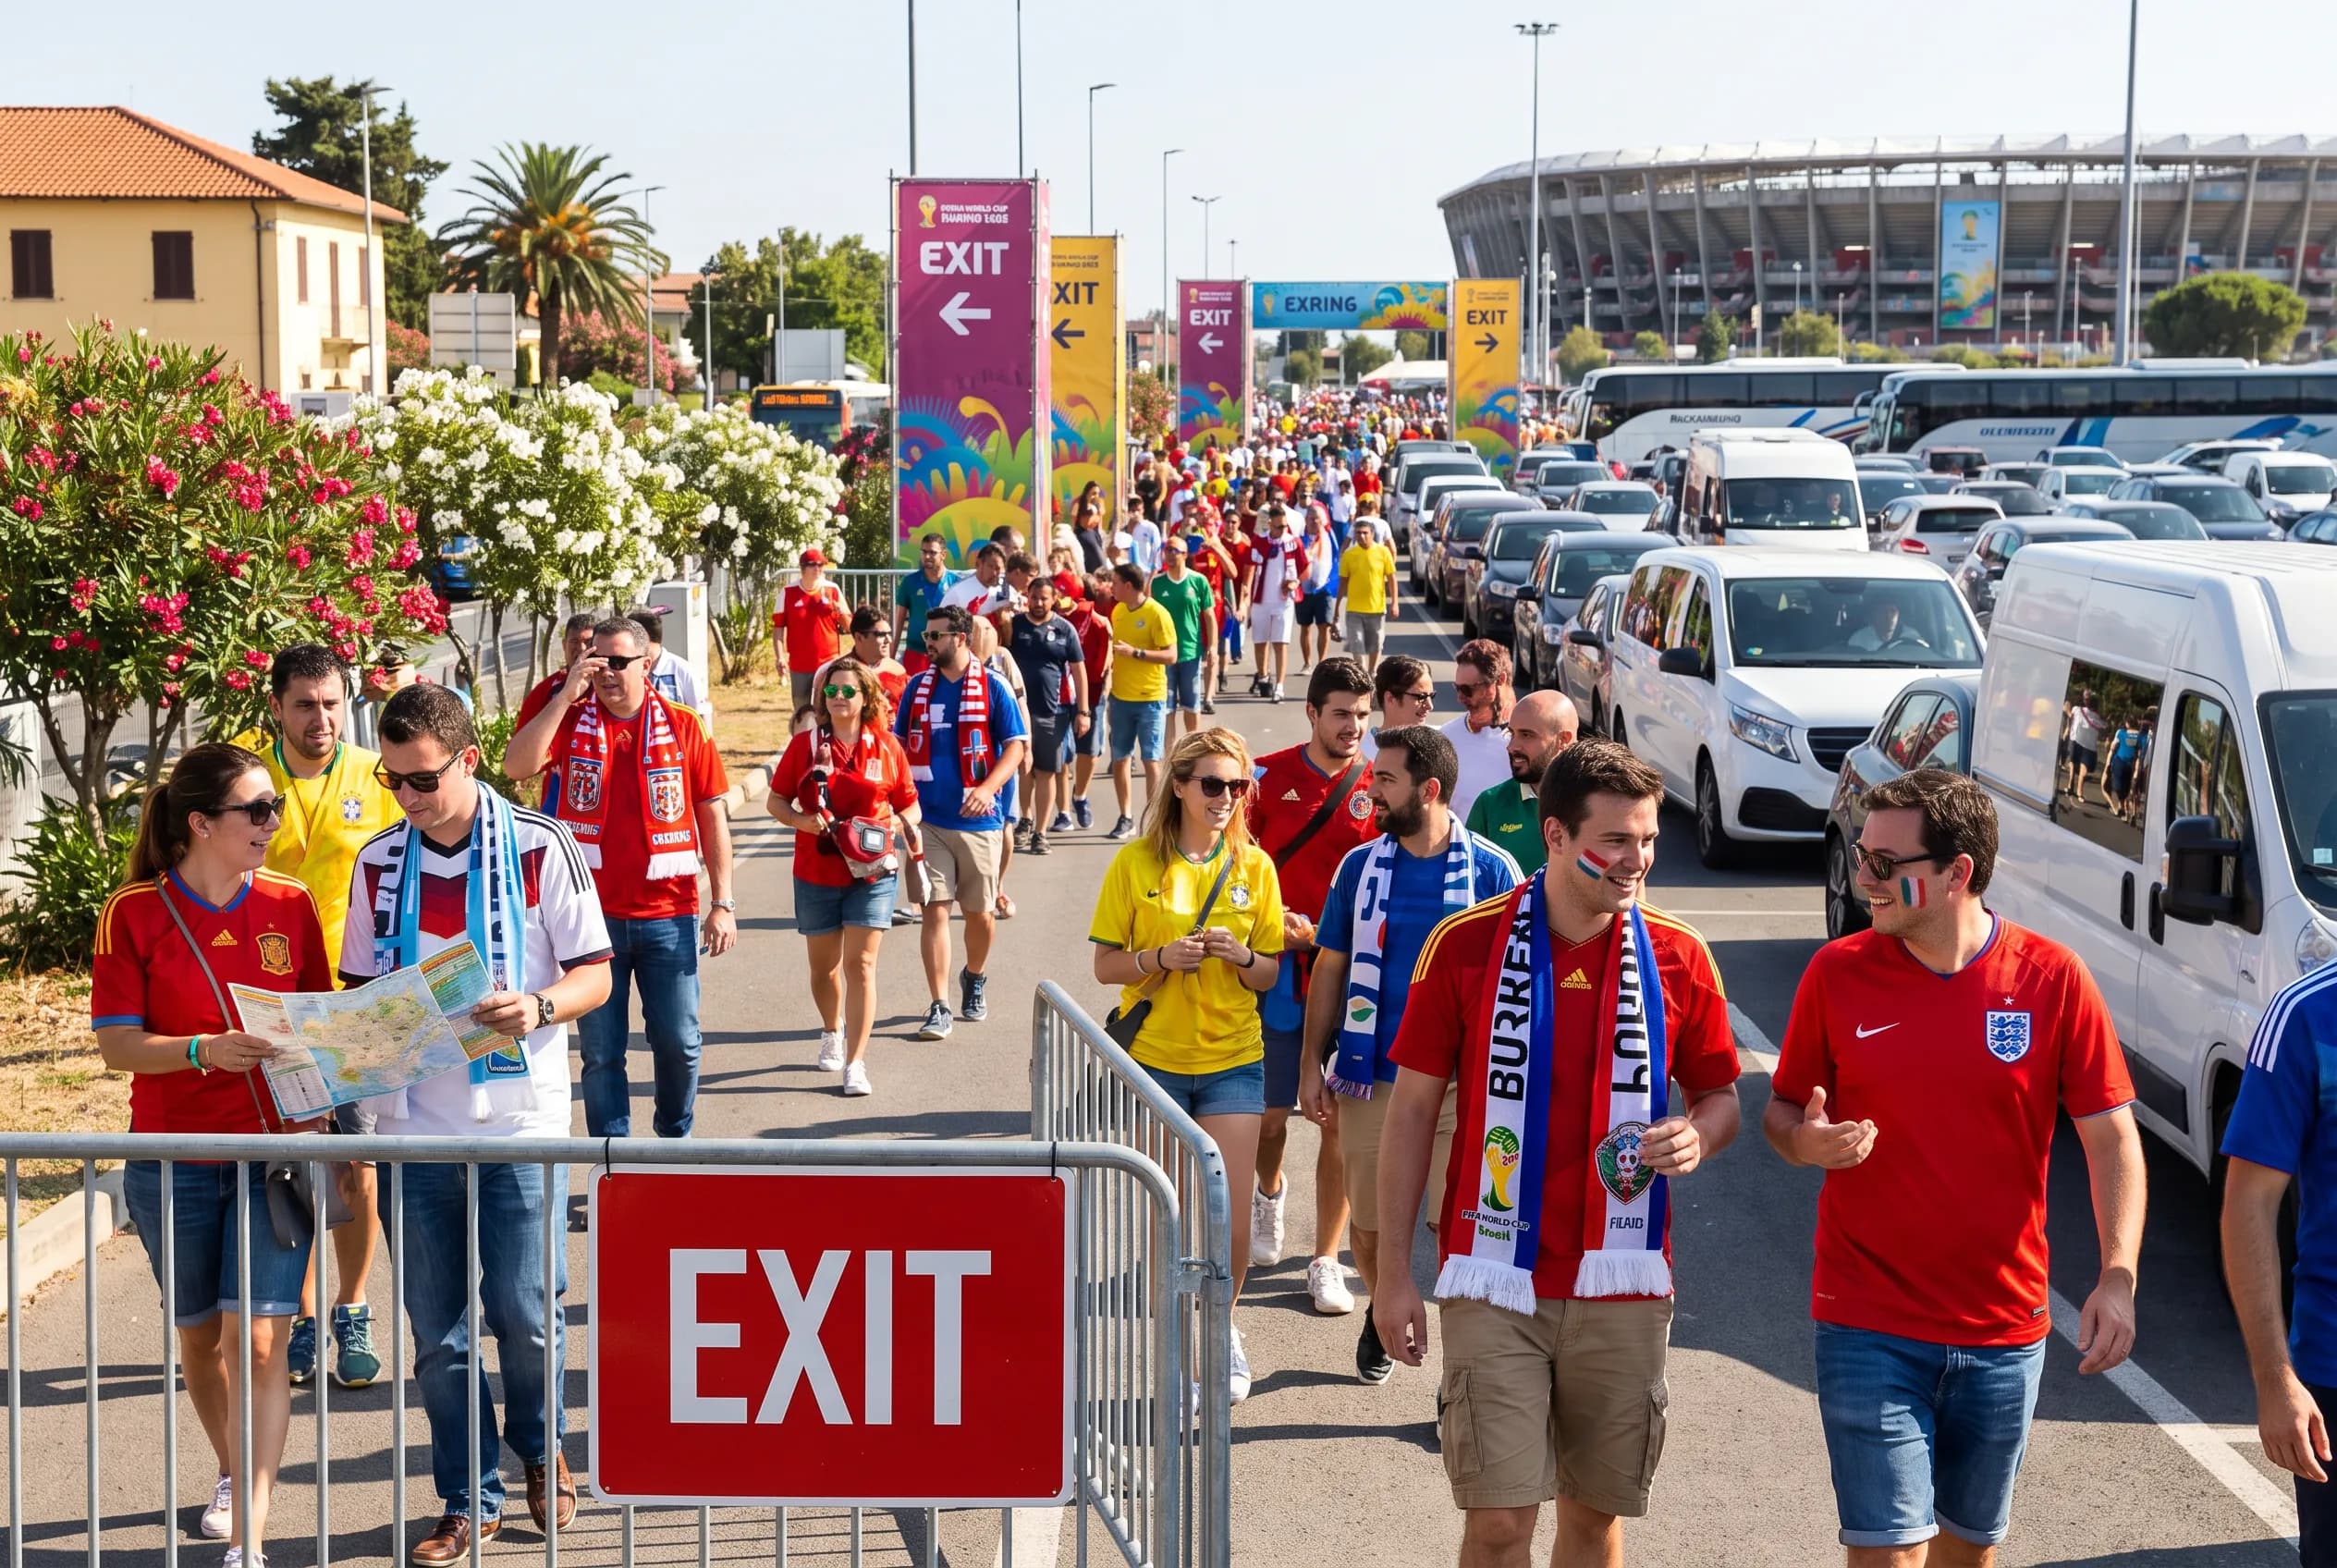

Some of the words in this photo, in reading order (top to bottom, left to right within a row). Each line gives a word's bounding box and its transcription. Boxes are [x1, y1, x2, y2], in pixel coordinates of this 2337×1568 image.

[920, 241, 1009, 275] EXIT
[1053, 281, 1100, 305] XIT
[1285, 296, 1358, 312] EXRING
[1190, 309, 1233, 326] EXIT
[1466, 310, 1509, 325] EXIT
[669, 1248, 992, 1426] EXIT
